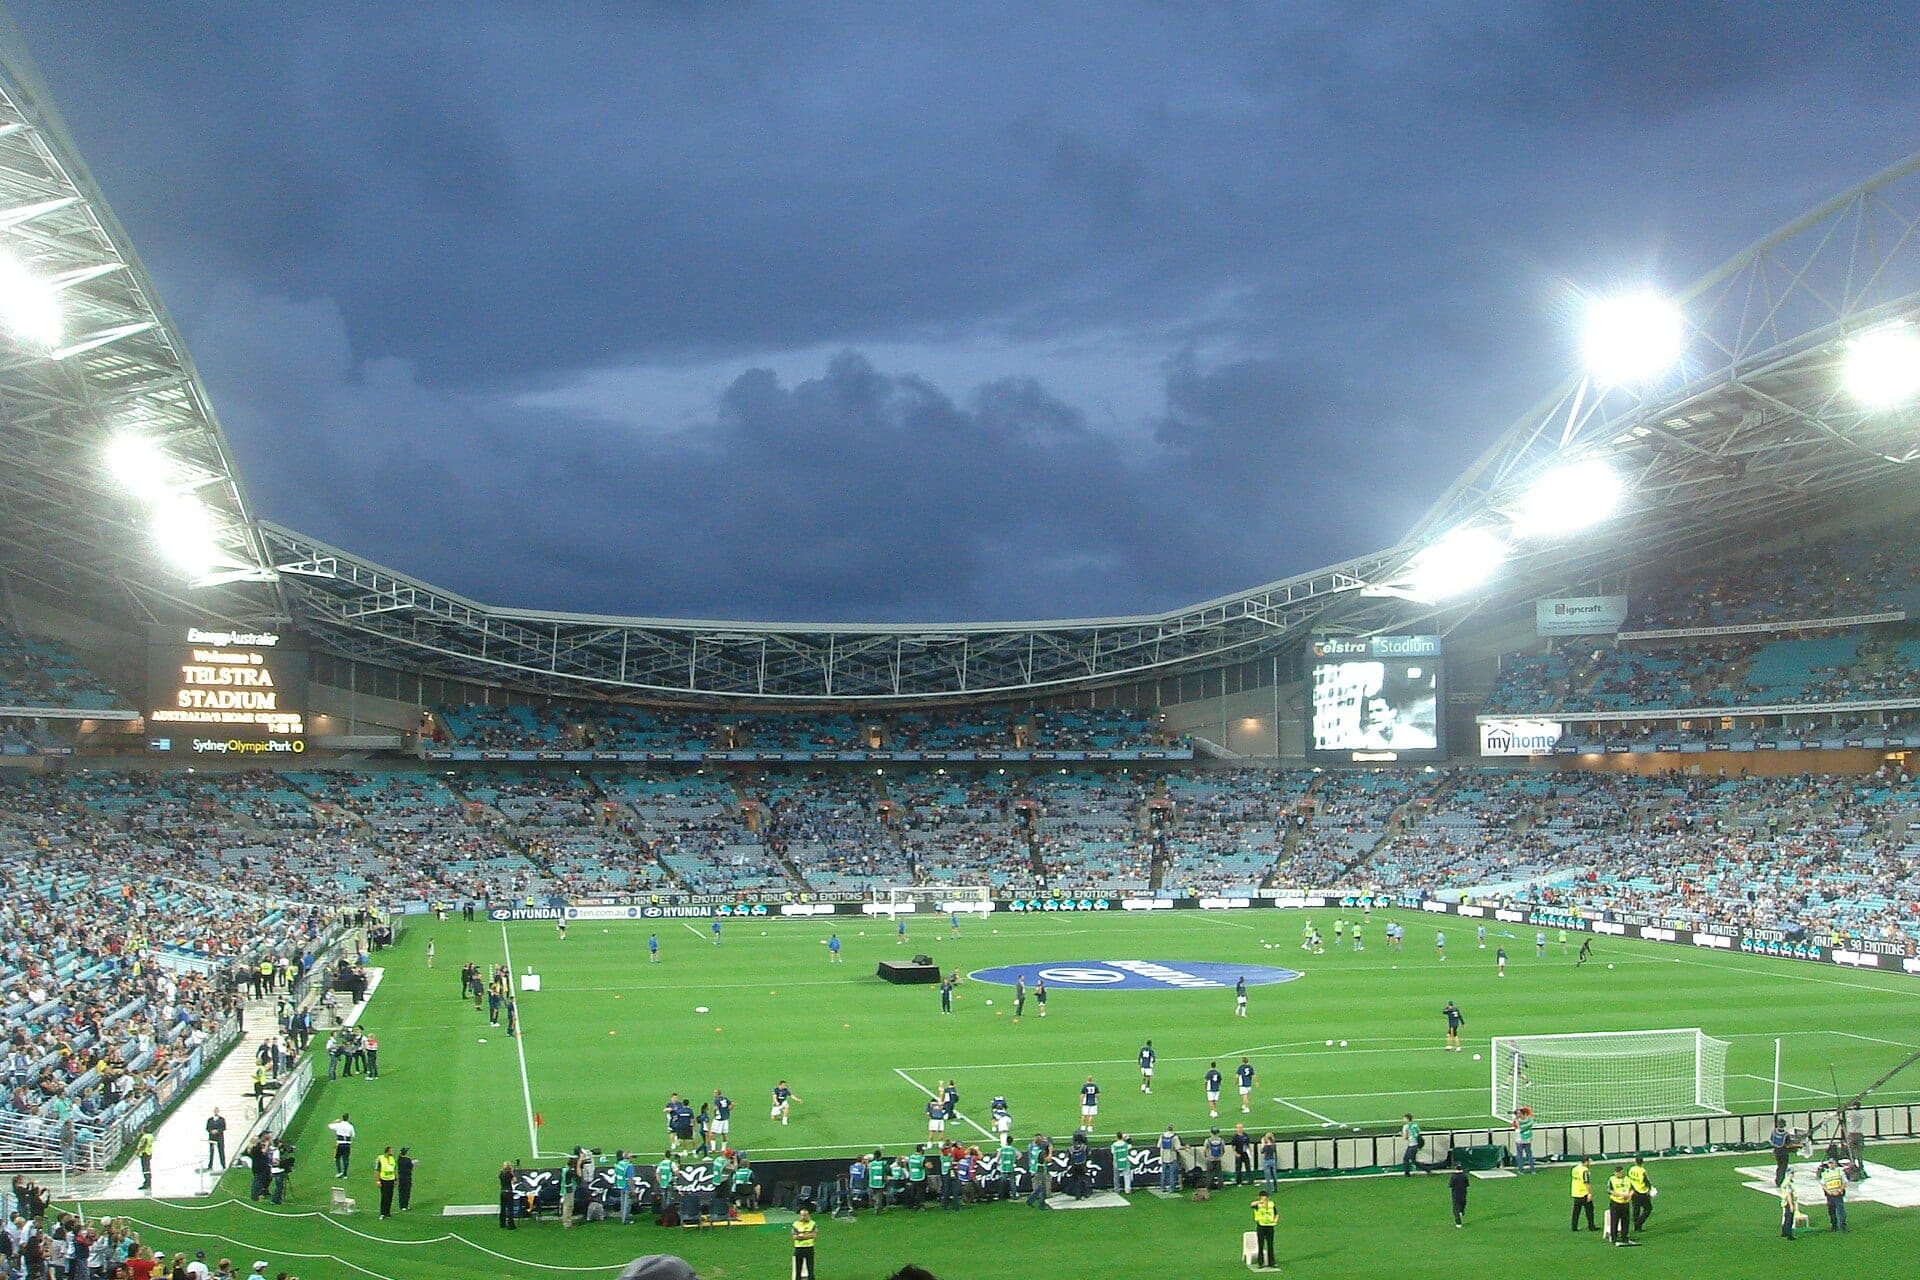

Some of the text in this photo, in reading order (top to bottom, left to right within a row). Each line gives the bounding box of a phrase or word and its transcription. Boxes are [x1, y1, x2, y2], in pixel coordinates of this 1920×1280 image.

[1380, 640, 1435, 653] Stadium
[250, 653, 264, 665] to
[182, 666, 274, 686] TELSTRA
[177, 689, 277, 709] STADIUM
[1487, 732, 1555, 753] myhome
[1074, 889, 1118, 898] EMOTIONS
[634, 895, 671, 905] MINES
[512, 908, 561, 919] HYUNDAI
[663, 906, 711, 917] HYUNDAI
[1754, 929, 1786, 942] EMOTION
[1850, 939, 1861, 951] 90
[1864, 940, 1905, 956] EMOTIONS
